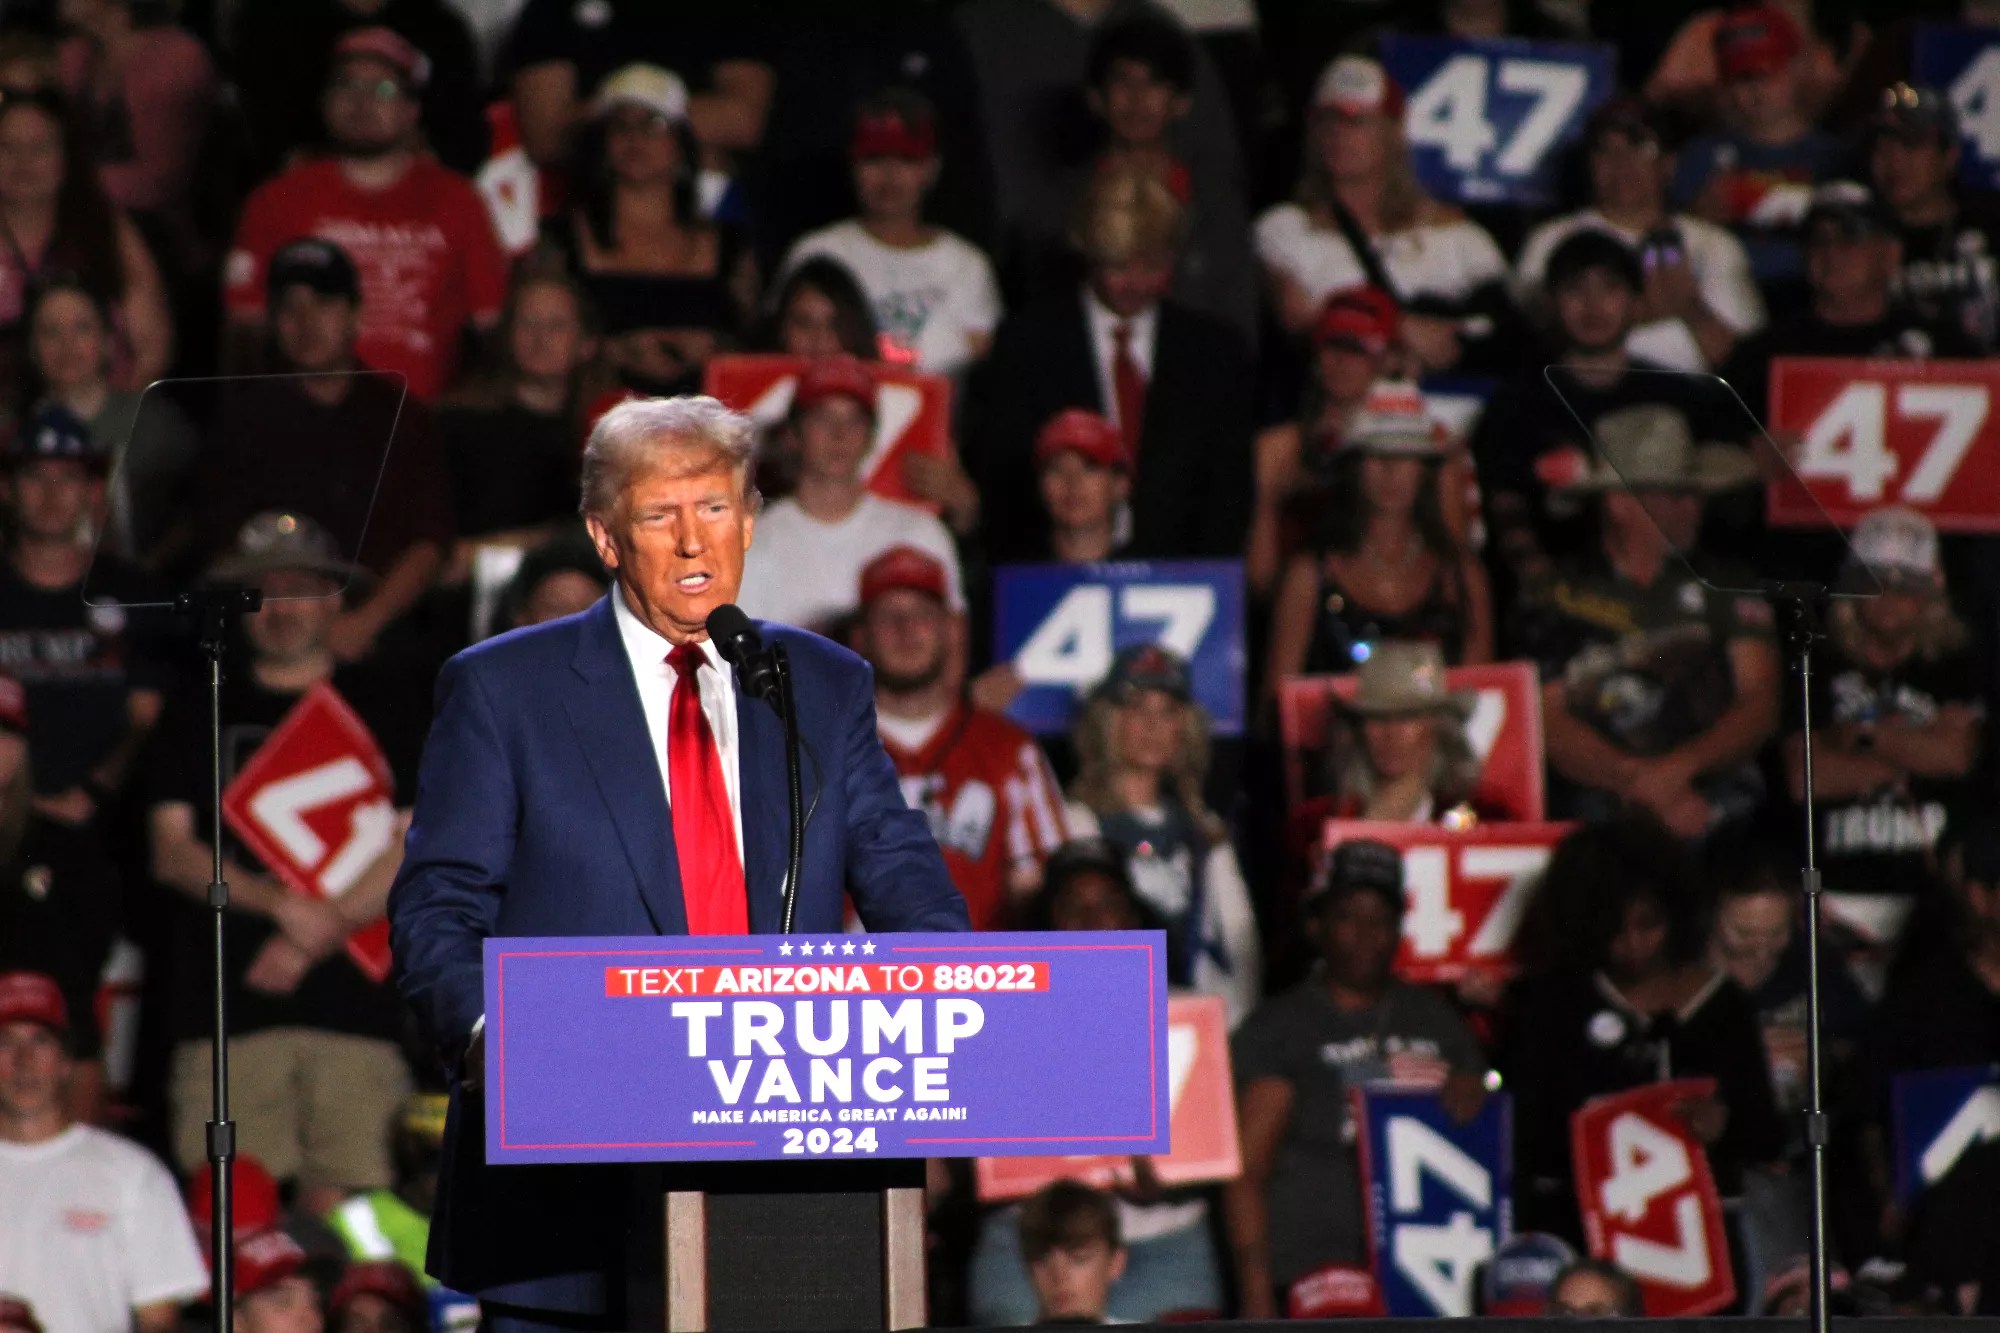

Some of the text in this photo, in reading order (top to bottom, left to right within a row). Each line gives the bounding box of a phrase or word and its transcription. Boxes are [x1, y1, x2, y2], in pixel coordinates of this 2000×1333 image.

[1404, 55, 1590, 176] 47
[1796, 380, 1990, 503] 47
[1013, 583, 1217, 698] 47
[619, 964, 1036, 994] TEXT ARIZONA TO 88022
[671, 998, 986, 1057] TRUMP
[691, 1106, 967, 1125] MAKE AMERICA GREAT AGAIN!
[707, 1056, 951, 1104] VANCE
[782, 1127, 879, 1155] 2024
[1386, 1115, 1495, 1317] 47
[1600, 1112, 1712, 1288] 47
